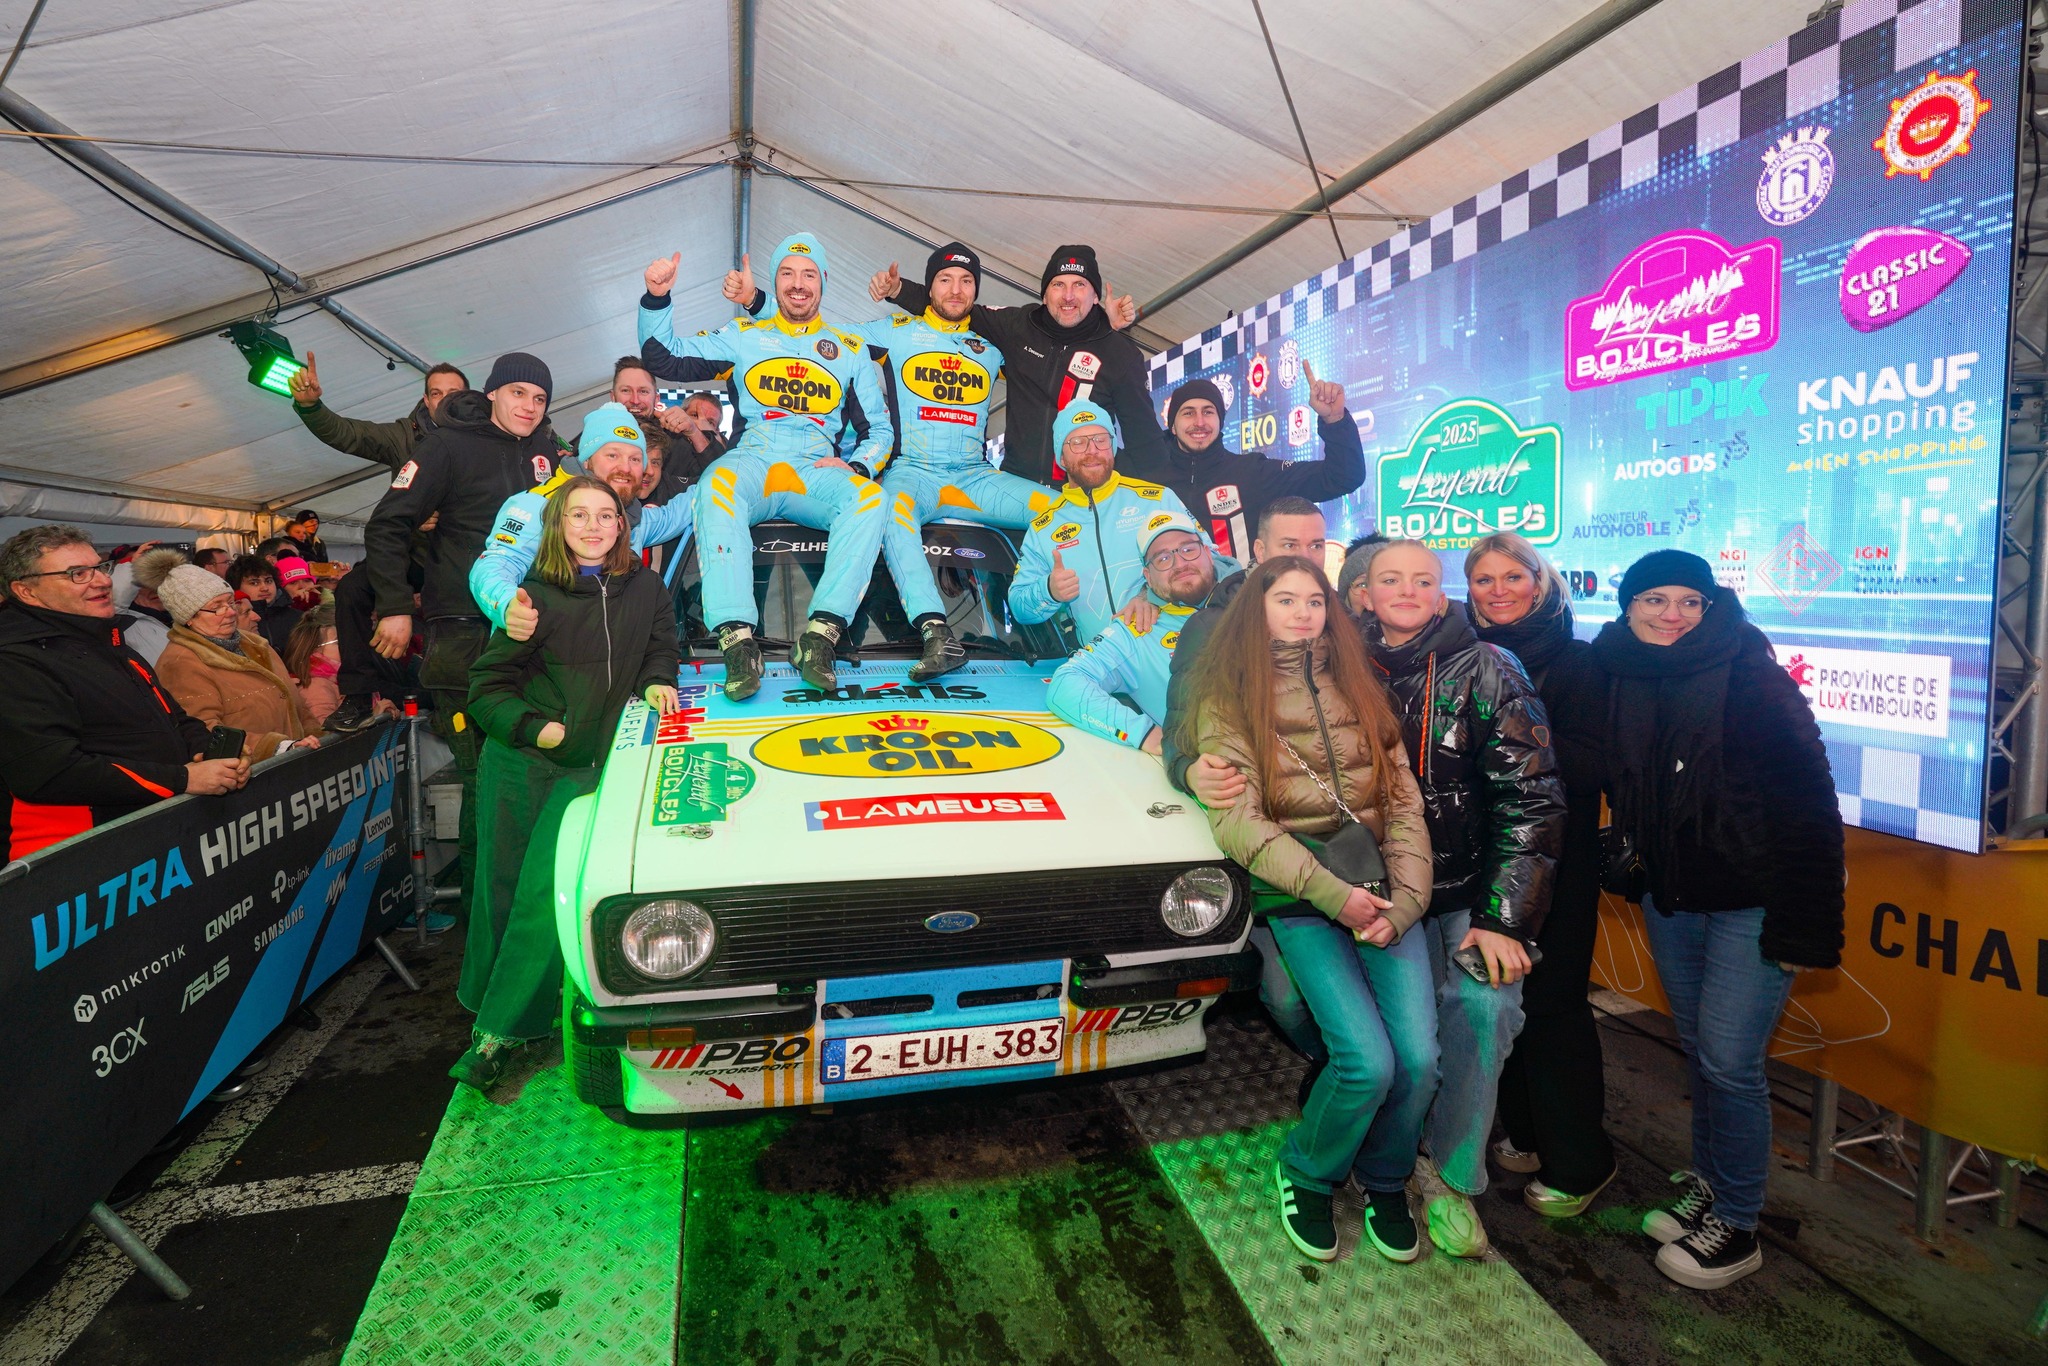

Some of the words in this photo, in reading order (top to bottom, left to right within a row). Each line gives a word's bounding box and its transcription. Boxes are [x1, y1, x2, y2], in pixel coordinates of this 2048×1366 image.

[1060, 263, 1085, 271] ANDES
[1846, 243, 1946, 297] CLASSIC
[1867, 288, 1899, 318] 21
[821, 341, 835, 353] SPA
[843, 337, 859, 349] OMP
[1576, 313, 1761, 378] BOUCLES
[915, 366, 983, 389] KROON
[1072, 362, 1095, 375] ANDES
[759, 375, 831, 400] KROON
[933, 385, 964, 402] OIL
[1798, 351, 1980, 415] KNAUF
[778, 394, 810, 412] OIL
[617, 429, 636, 438] KROON
[1442, 420, 1477, 447] 2025
[1797, 400, 1976, 445] shopping
[1401, 437, 1536, 520] Legend
[1142, 489, 1160, 497] OMP
[1212, 499, 1238, 509] ANDES
[1035, 515, 1050, 528] OMP
[1150, 516, 1169, 528] KROON
[1386, 503, 1546, 537] BOUCLES
[1591, 511, 1648, 523] MONITEUR
[1055, 527, 1077, 540] KROON
[1061, 534, 1072, 542] OIL
[760, 539, 828, 552] DELHE
[922, 545, 952, 556] OZ
[1720, 550, 1746, 561] NGI
[1855, 546, 1889, 559] IGN
[724, 633, 739, 646] OMP
[1914, 677, 1938, 698] DE
[1819, 689, 1937, 721] LUXEMBOURG
[615, 692, 645, 752] EAUFAYS
[799, 730, 1022, 757] KROON
[868, 750, 973, 772] OIL
[658, 747, 685, 822] BOUCLES
[367, 815, 392, 839] Lenovo
[31, 845, 193, 972] ULTRA
[200, 796, 284, 877] HIGH
[290, 763, 367, 831] SPEED
[368, 743, 409, 789] INTE
[325, 838, 357, 869] iiyama
[287, 865, 310, 890] tp-link
[380, 873, 415, 915] CYB
[205, 895, 254, 943] QNAP
[254, 905, 305, 952] SAMSUNG
[180, 956, 230, 1013] ASUS
[1114, 999, 1203, 1030] PBO
[1104, 1018, 1190, 1038] MOTORSPORT
[92, 1017, 148, 1078] 3CX
[698, 1036, 811, 1068] PBO
[690, 1062, 804, 1077] MOTORSPORT
[826, 1065, 840, 1079] B
